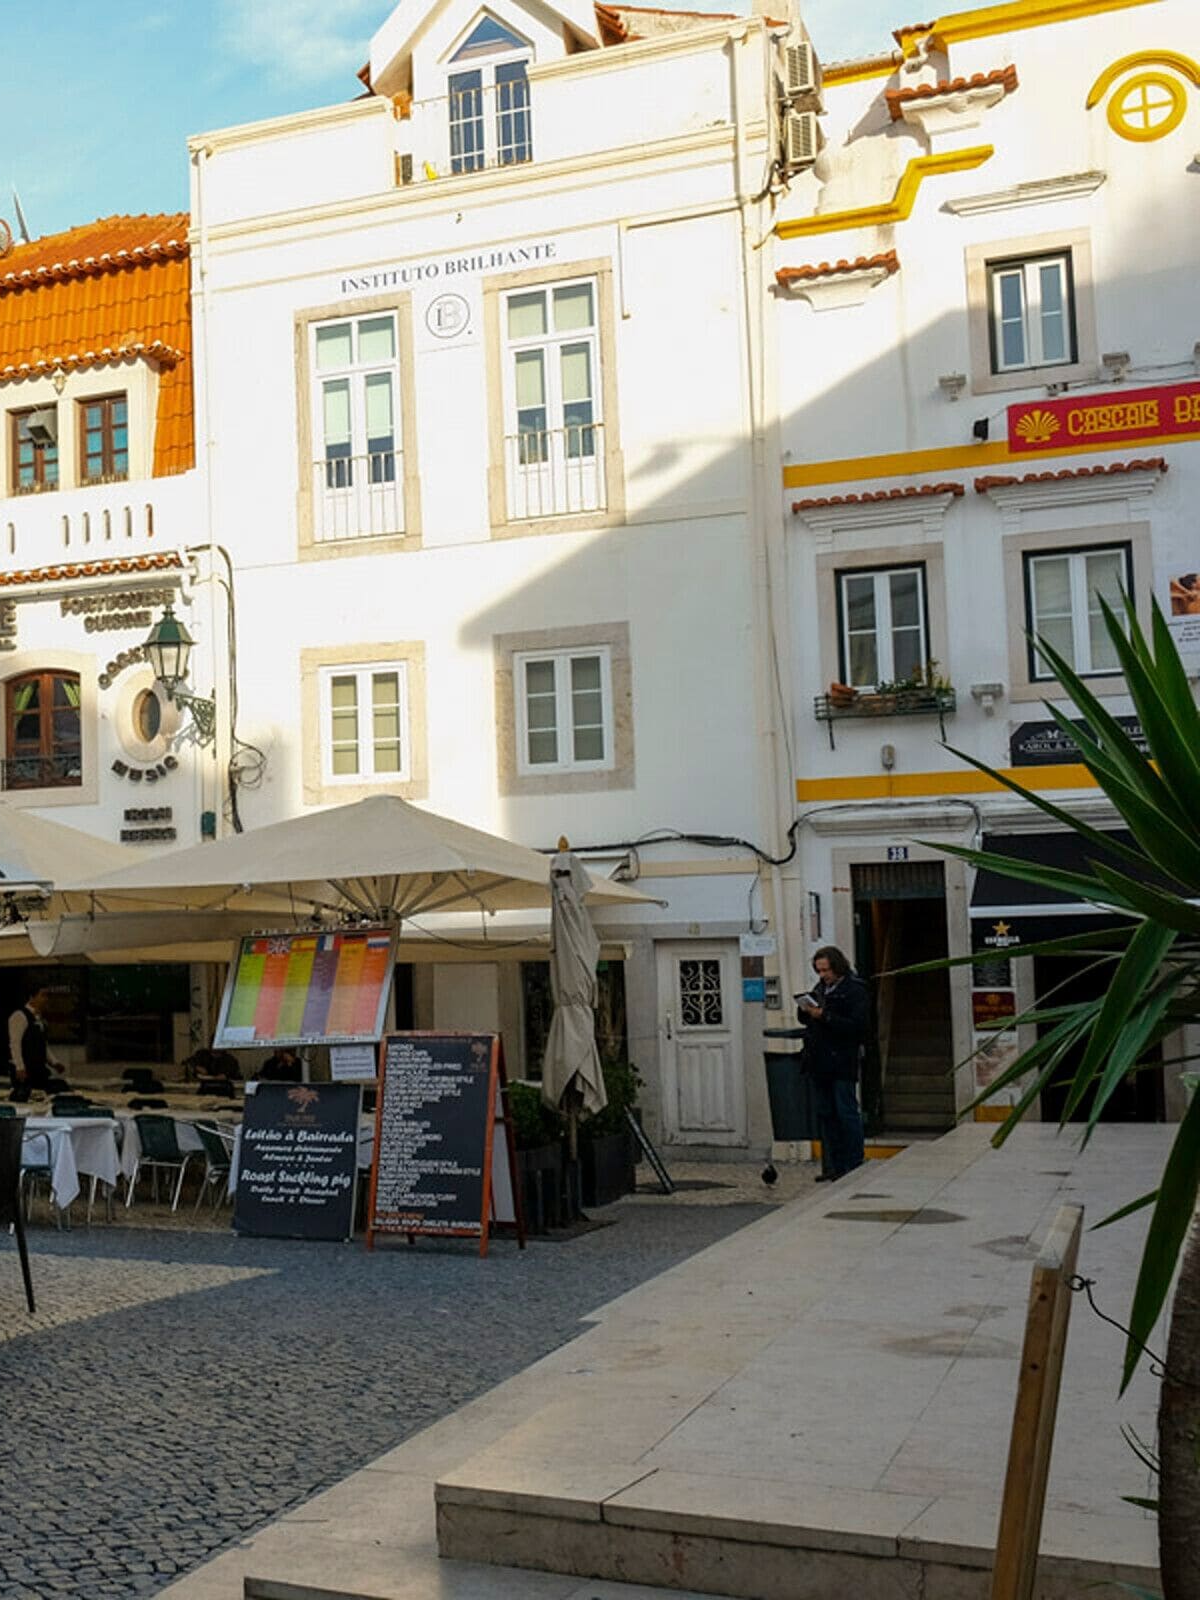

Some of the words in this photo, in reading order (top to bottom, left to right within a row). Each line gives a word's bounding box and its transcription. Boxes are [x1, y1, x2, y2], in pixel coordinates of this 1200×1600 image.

[341, 263, 440, 294] INSTITUTO
[445, 243, 557, 276] BRILHANTE
[1067, 400, 1160, 437] CASCAIS
[111, 755, 179, 783] MUSIC
